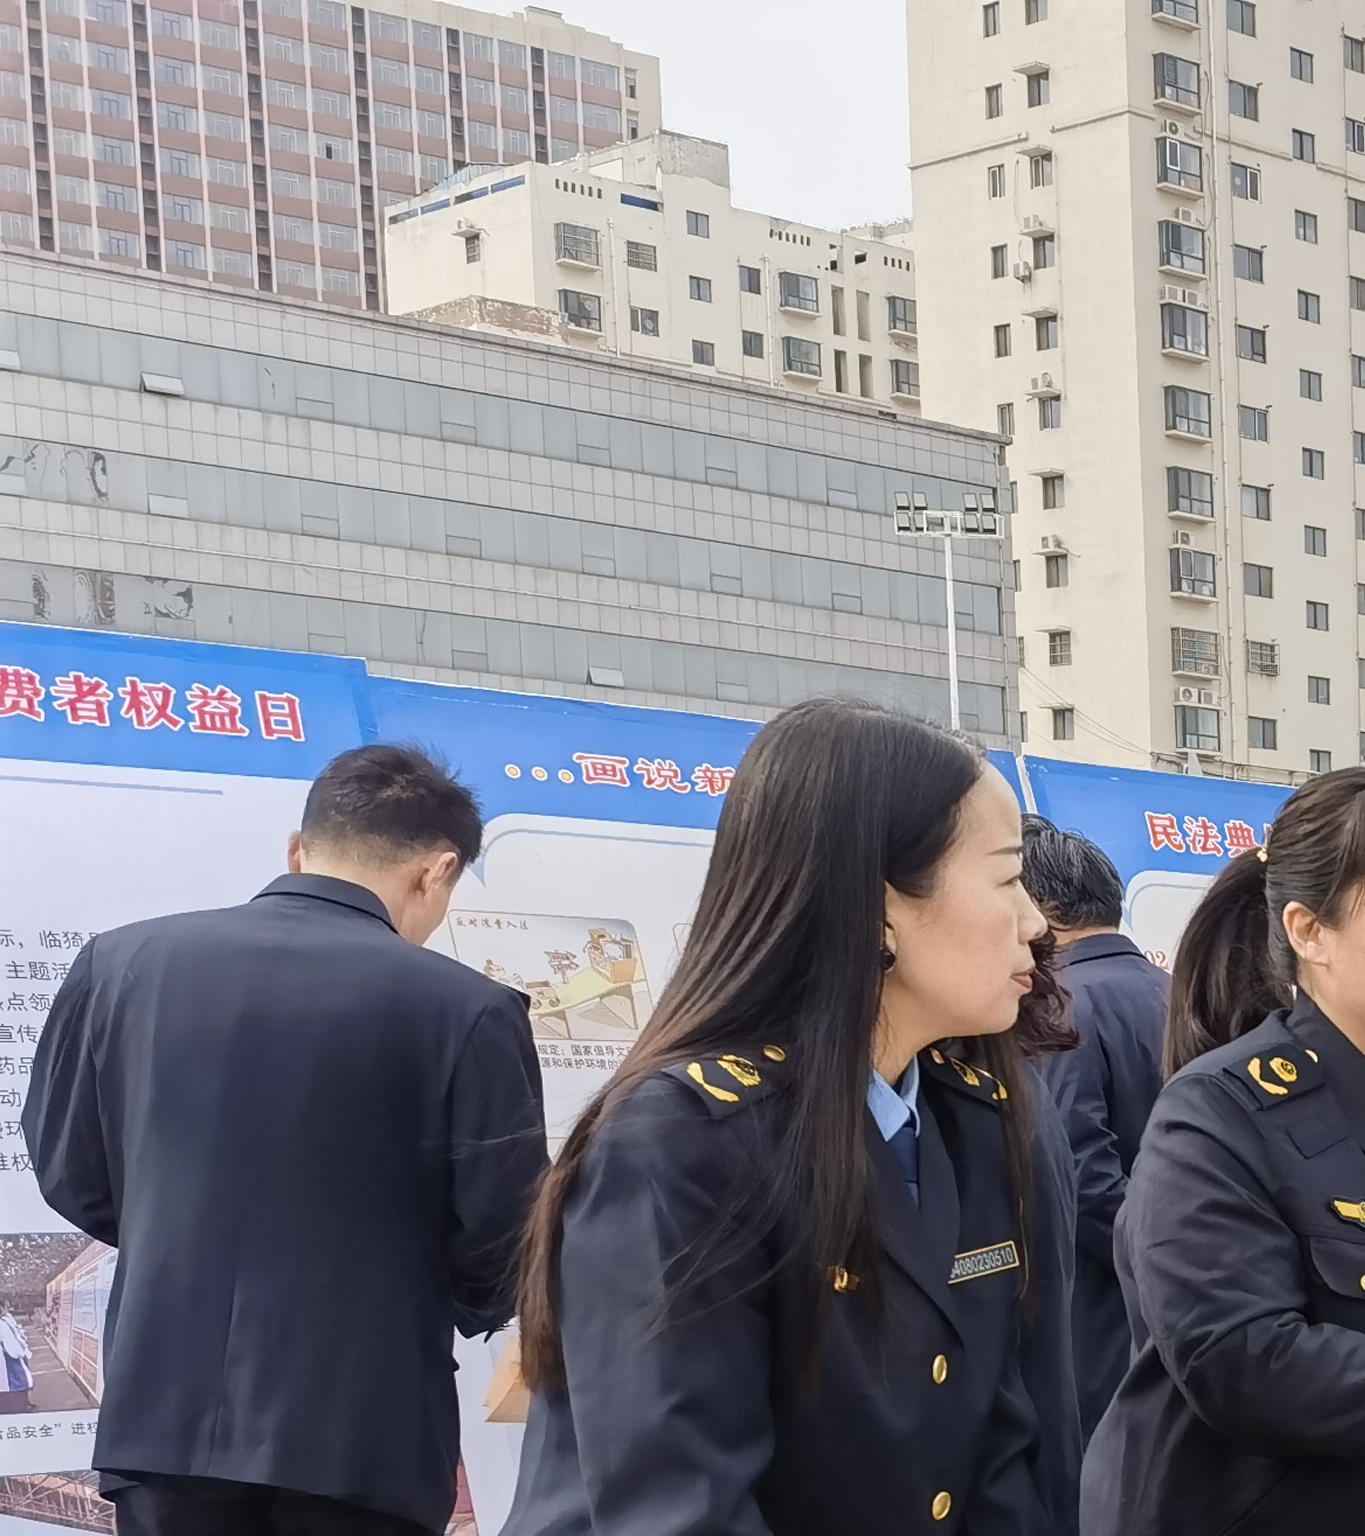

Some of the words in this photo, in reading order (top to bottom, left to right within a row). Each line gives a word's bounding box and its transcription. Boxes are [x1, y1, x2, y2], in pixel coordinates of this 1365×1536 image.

[0, 664, 305, 742] 费者权益日
[573, 752, 735, 796] 画说新
[1144, 811, 1272, 858] 民法典
[0, 928, 99, 951] 示，临猗
[0, 991, 57, 1011] 点领
[0, 1024, 44, 1044] 宣传
